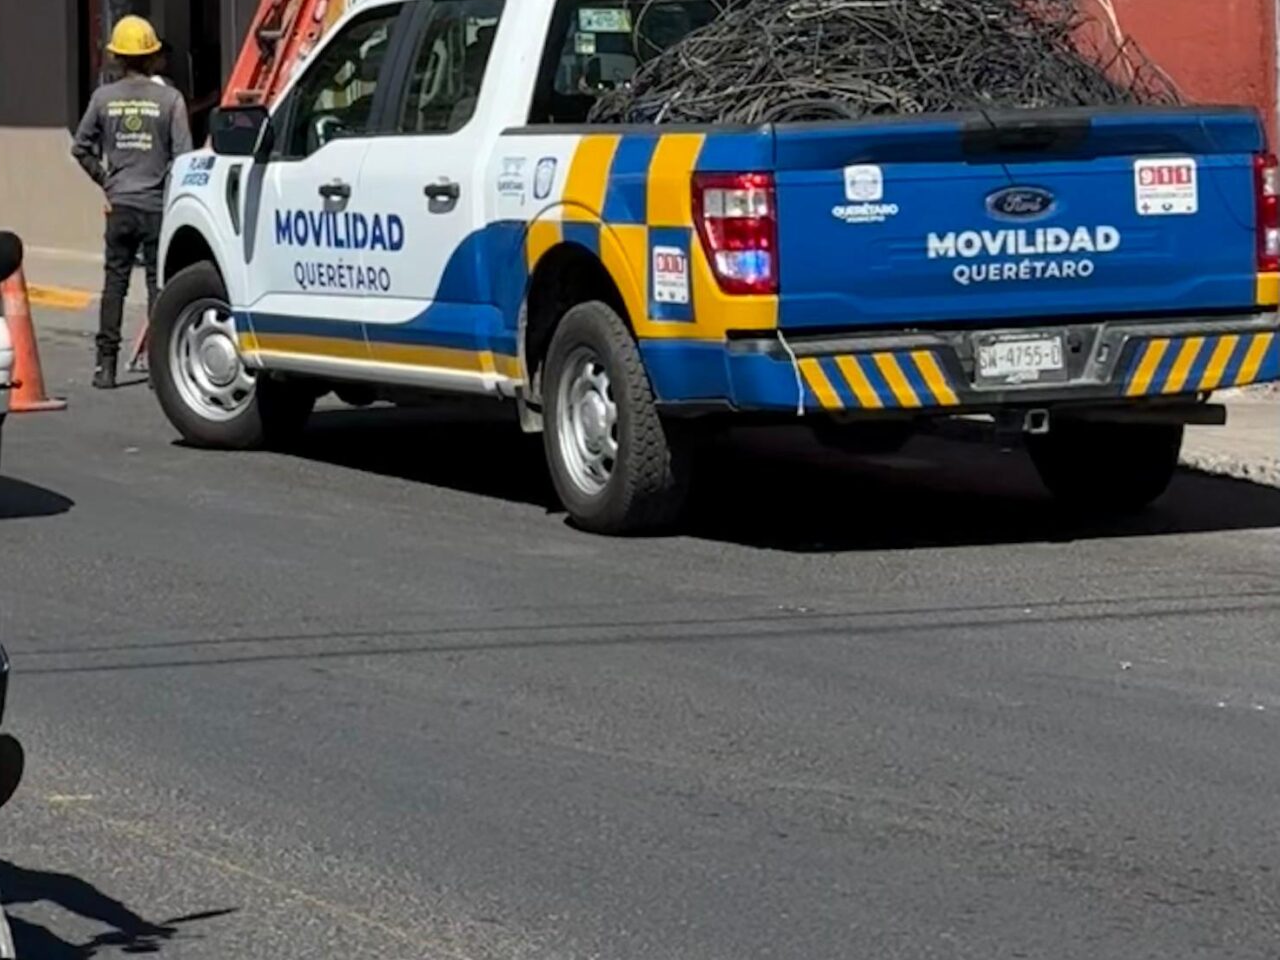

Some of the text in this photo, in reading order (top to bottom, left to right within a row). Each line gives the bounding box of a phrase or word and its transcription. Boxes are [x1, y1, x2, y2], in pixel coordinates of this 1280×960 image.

[1140, 167, 1189, 184] 911
[1003, 192, 1042, 212] Ford
[275, 208, 404, 251] MOVILIDAD
[927, 225, 1121, 258] MOVILIDAD
[293, 257, 391, 292] QUERÉTARO
[953, 258, 1095, 285] QUERÉTARO
